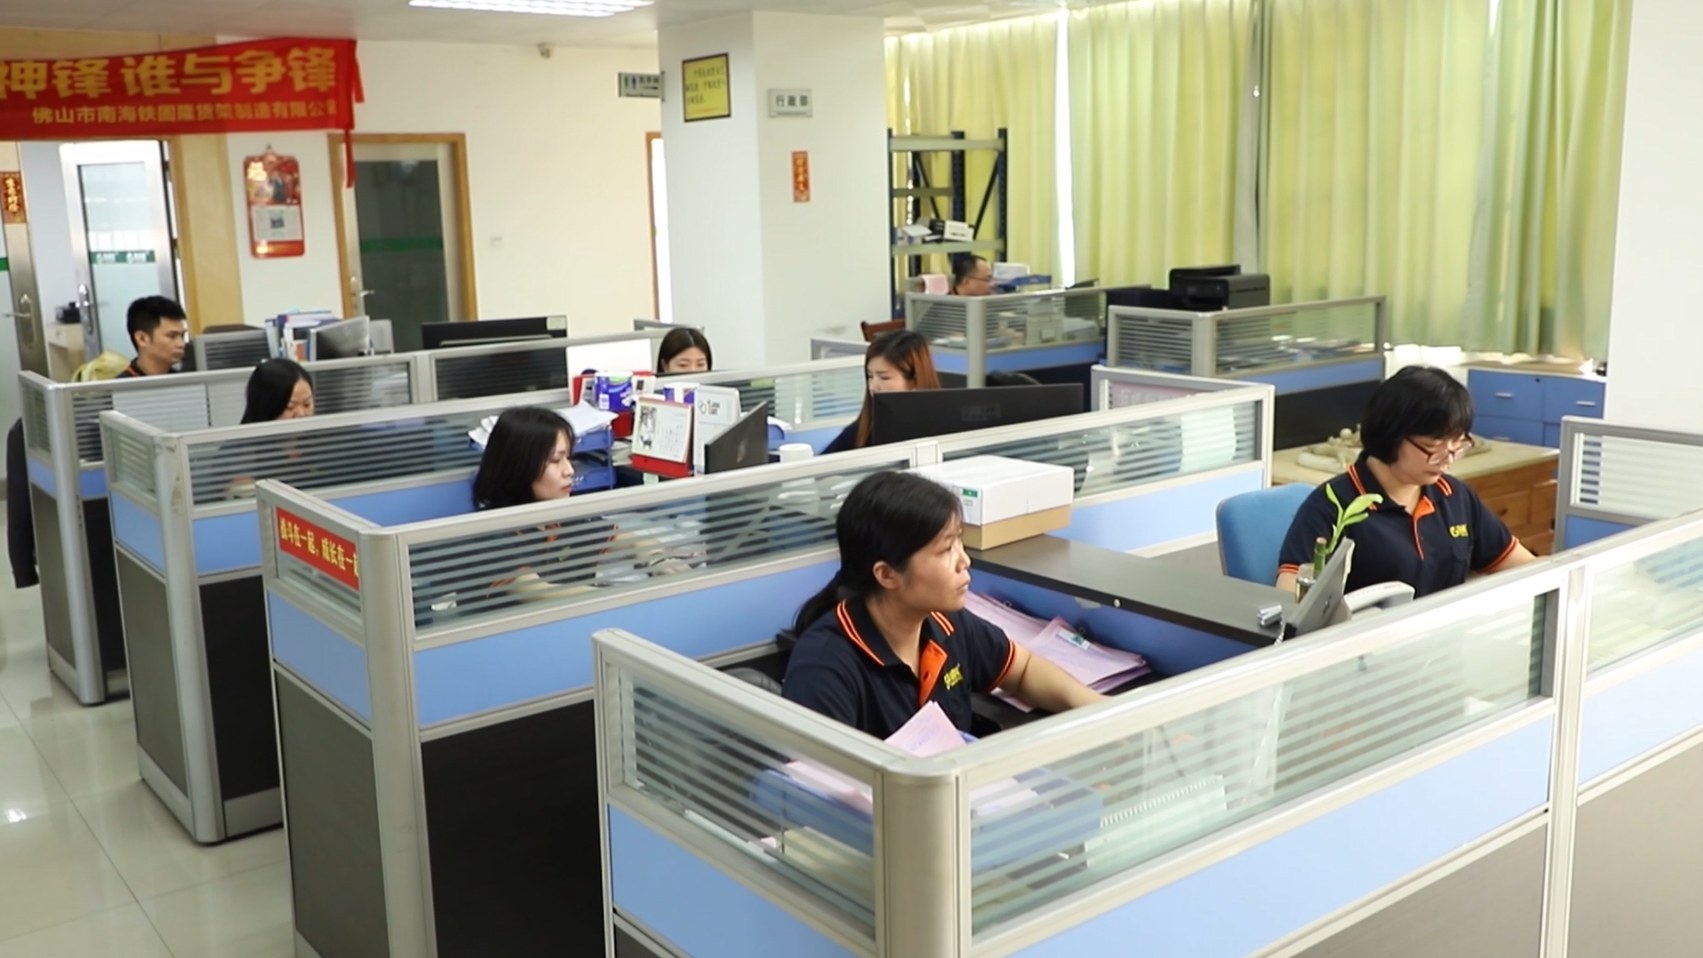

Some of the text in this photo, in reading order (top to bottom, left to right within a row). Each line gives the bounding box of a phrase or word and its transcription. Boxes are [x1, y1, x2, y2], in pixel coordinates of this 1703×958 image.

[120, 46, 335, 96] 谁与争锋
[776, 95, 808, 107] 行政部
